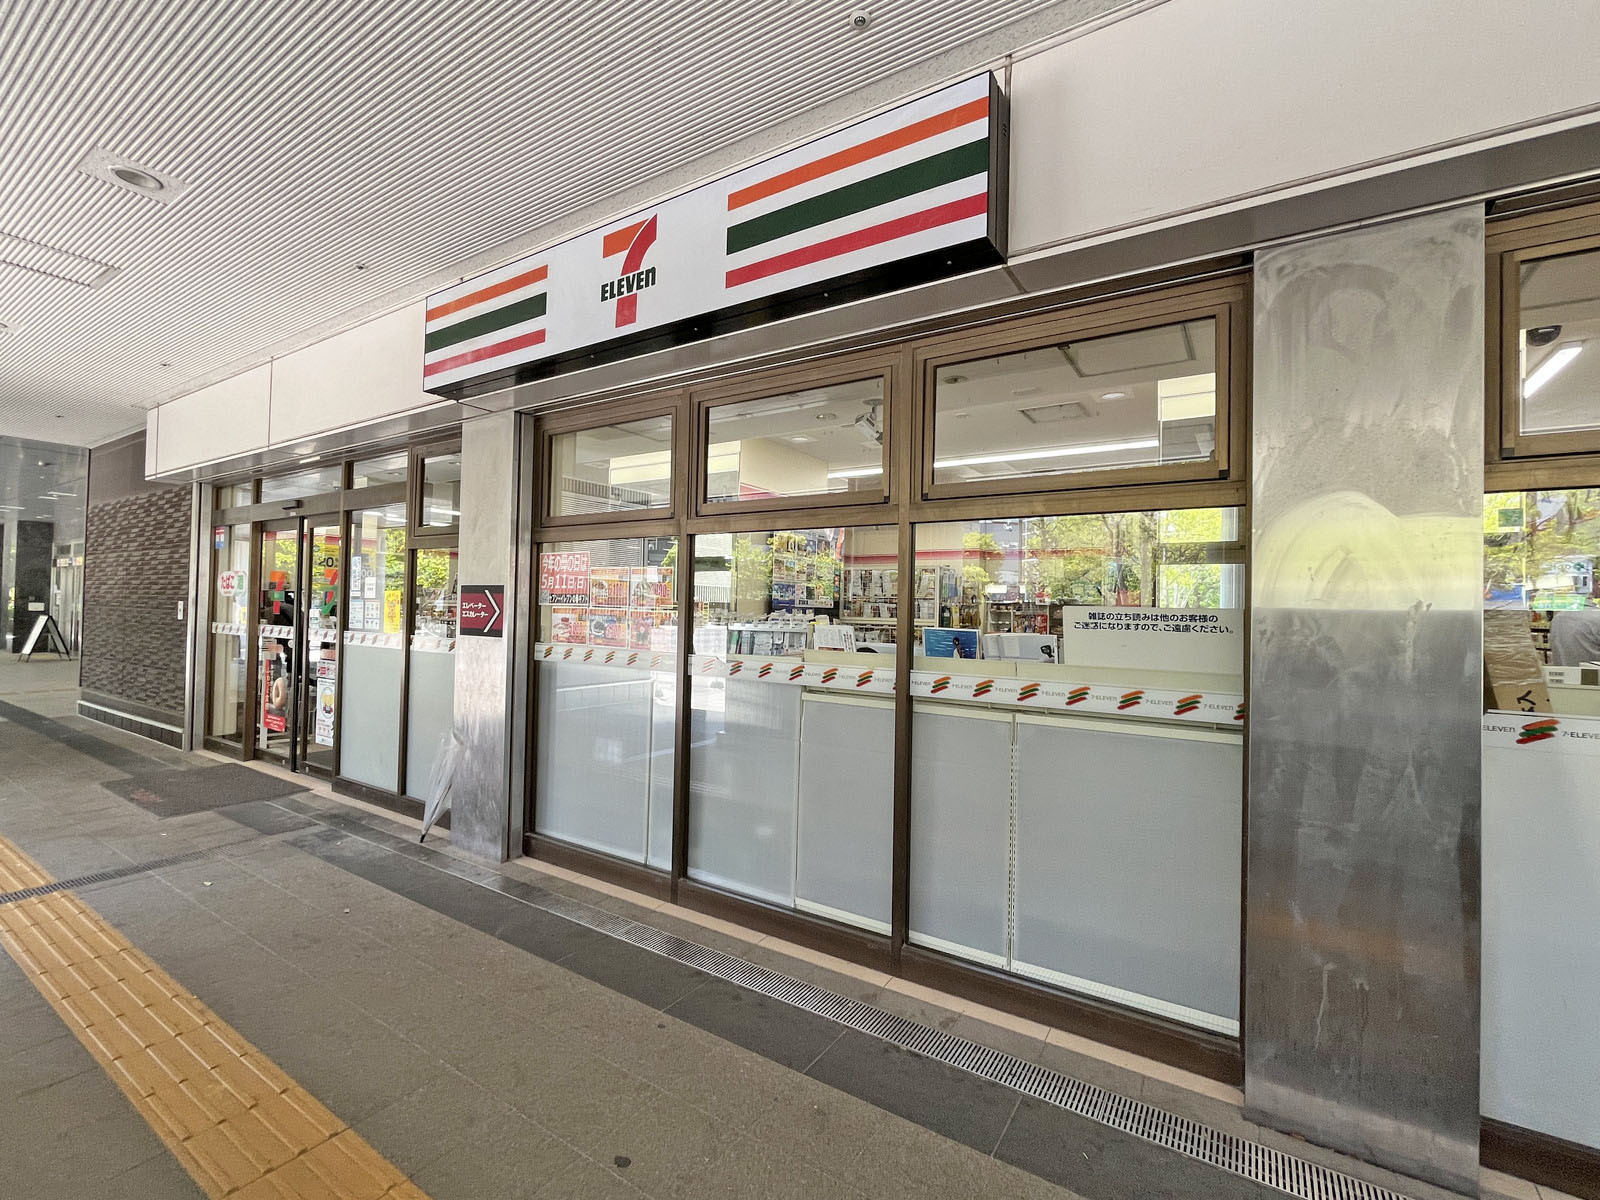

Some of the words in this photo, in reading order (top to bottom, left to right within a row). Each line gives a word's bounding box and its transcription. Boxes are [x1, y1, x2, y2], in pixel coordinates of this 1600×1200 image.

[1088, 611, 1219, 623] 雑誌の立ち読みは他のお客様の
